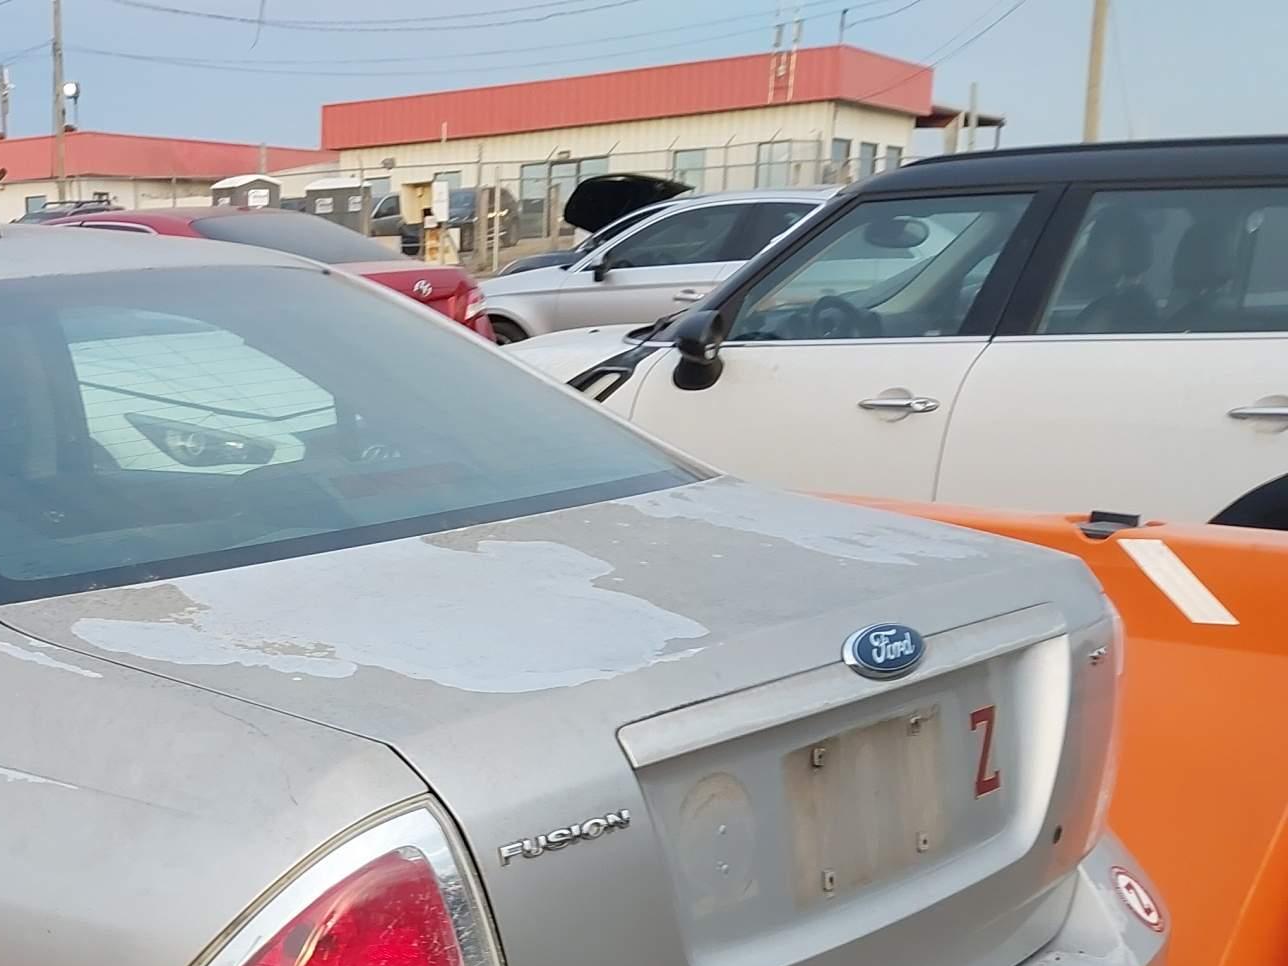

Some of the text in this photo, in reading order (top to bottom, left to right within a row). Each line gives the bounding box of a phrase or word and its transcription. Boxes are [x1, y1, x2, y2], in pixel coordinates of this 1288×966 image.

[869, 629, 916, 664] Ford
[969, 704, 1001, 799] Z
[498, 808, 631, 867] FUSION
